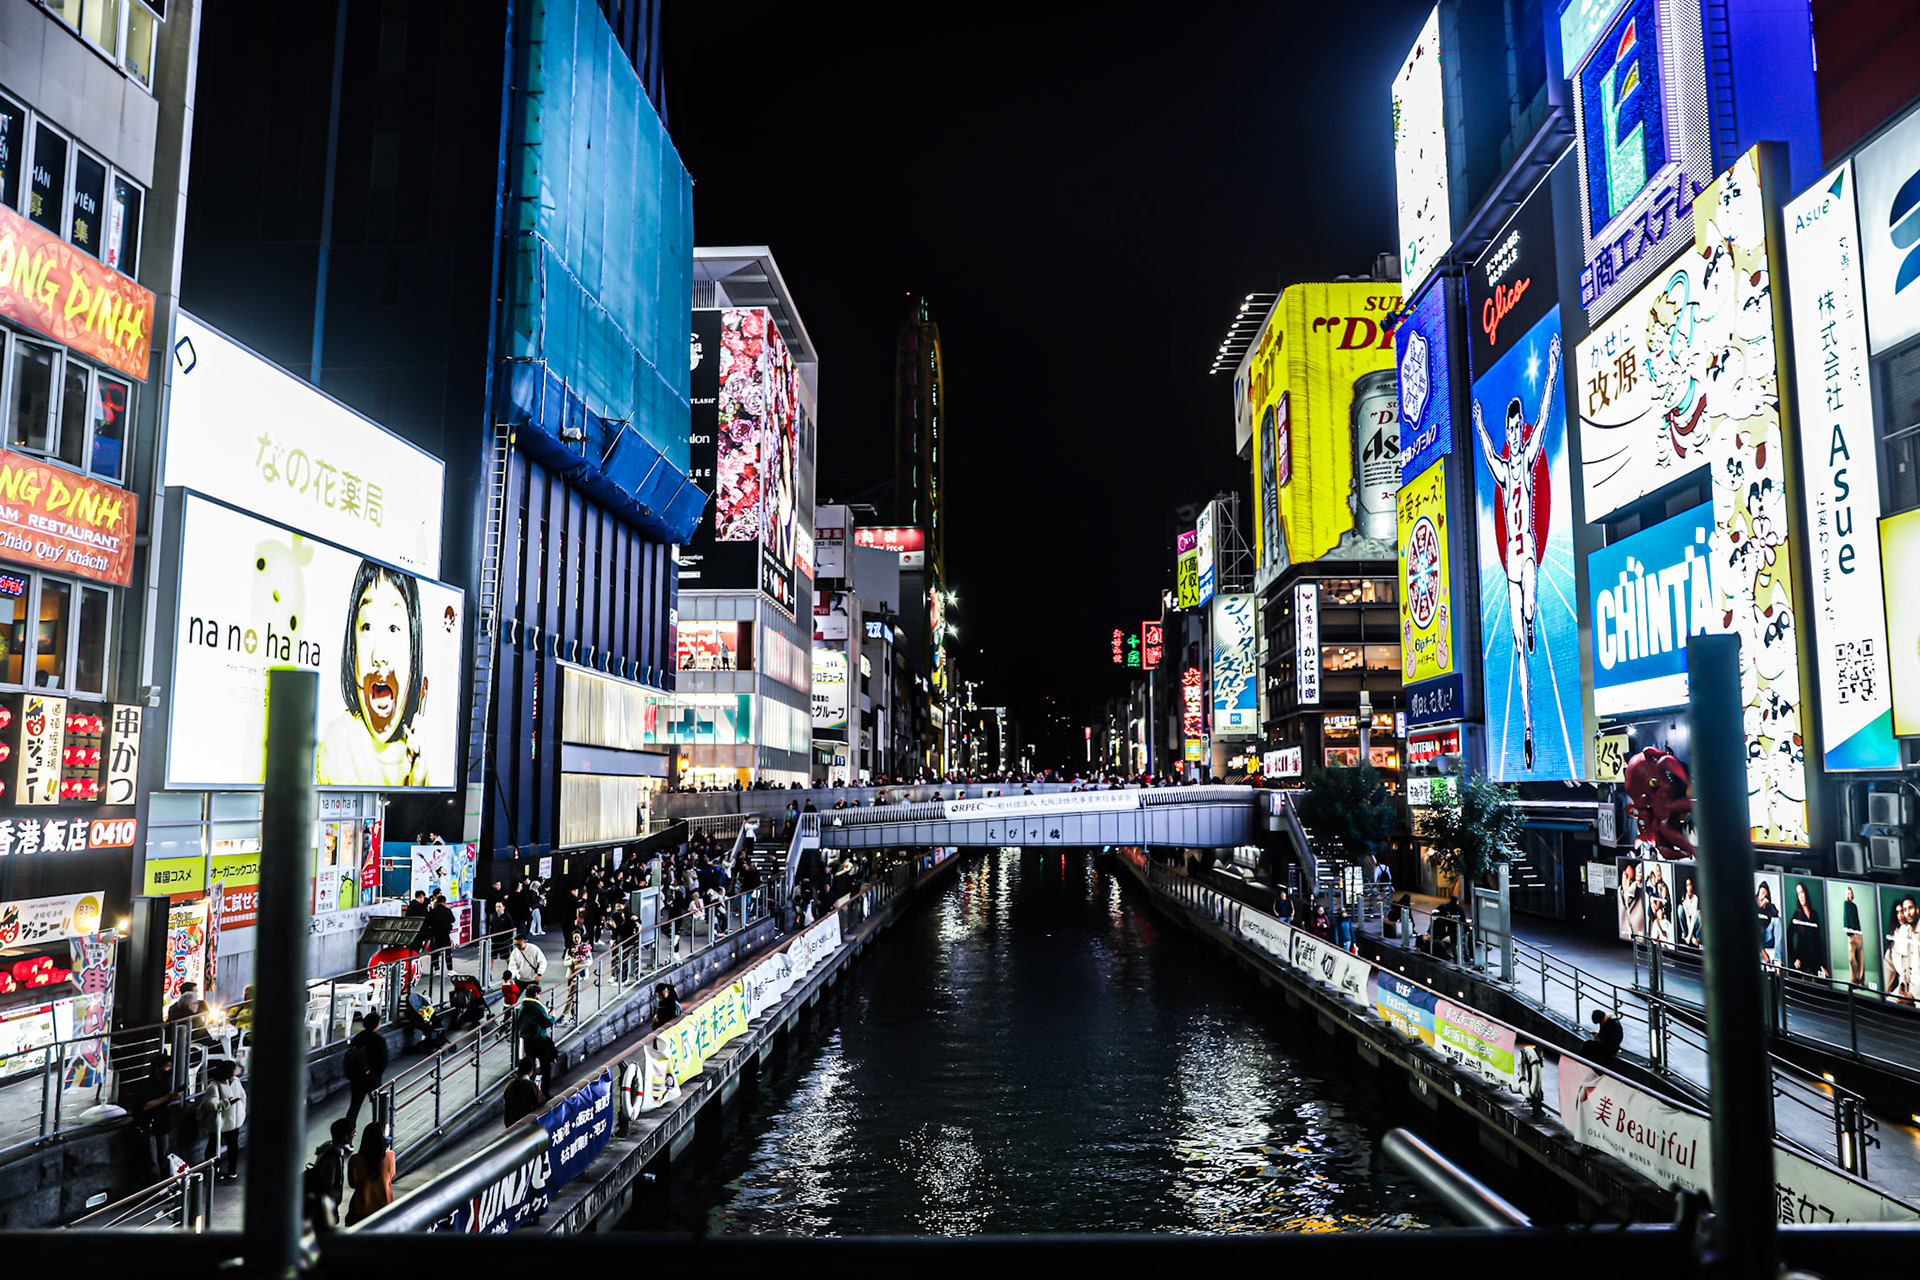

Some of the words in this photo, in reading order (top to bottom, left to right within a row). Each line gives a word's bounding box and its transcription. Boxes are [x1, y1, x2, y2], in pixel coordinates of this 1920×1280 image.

[1795, 199, 1830, 234] Asue
[64, 269, 145, 352] DINH
[1482, 277, 1530, 345] Glico
[1588, 346, 1637, 418] 改源
[1817, 290, 1844, 413] 株式会社
[46, 477, 122, 529] DINH
[257, 432, 383, 527] なの花薬局
[1829, 423, 1856, 575] Asue
[28, 513, 120, 549] RESTAURANT
[1512, 481, 1524, 556] グリコ
[1597, 530, 1722, 670] CHINTA
[110, 708, 138, 803] 串かつ
[0, 818, 89, 856] 香港飯店
[91, 821, 135, 846] 0410
[1595, 1096, 1613, 1128] 美
[1616, 1106, 1697, 1169] Beauiful
